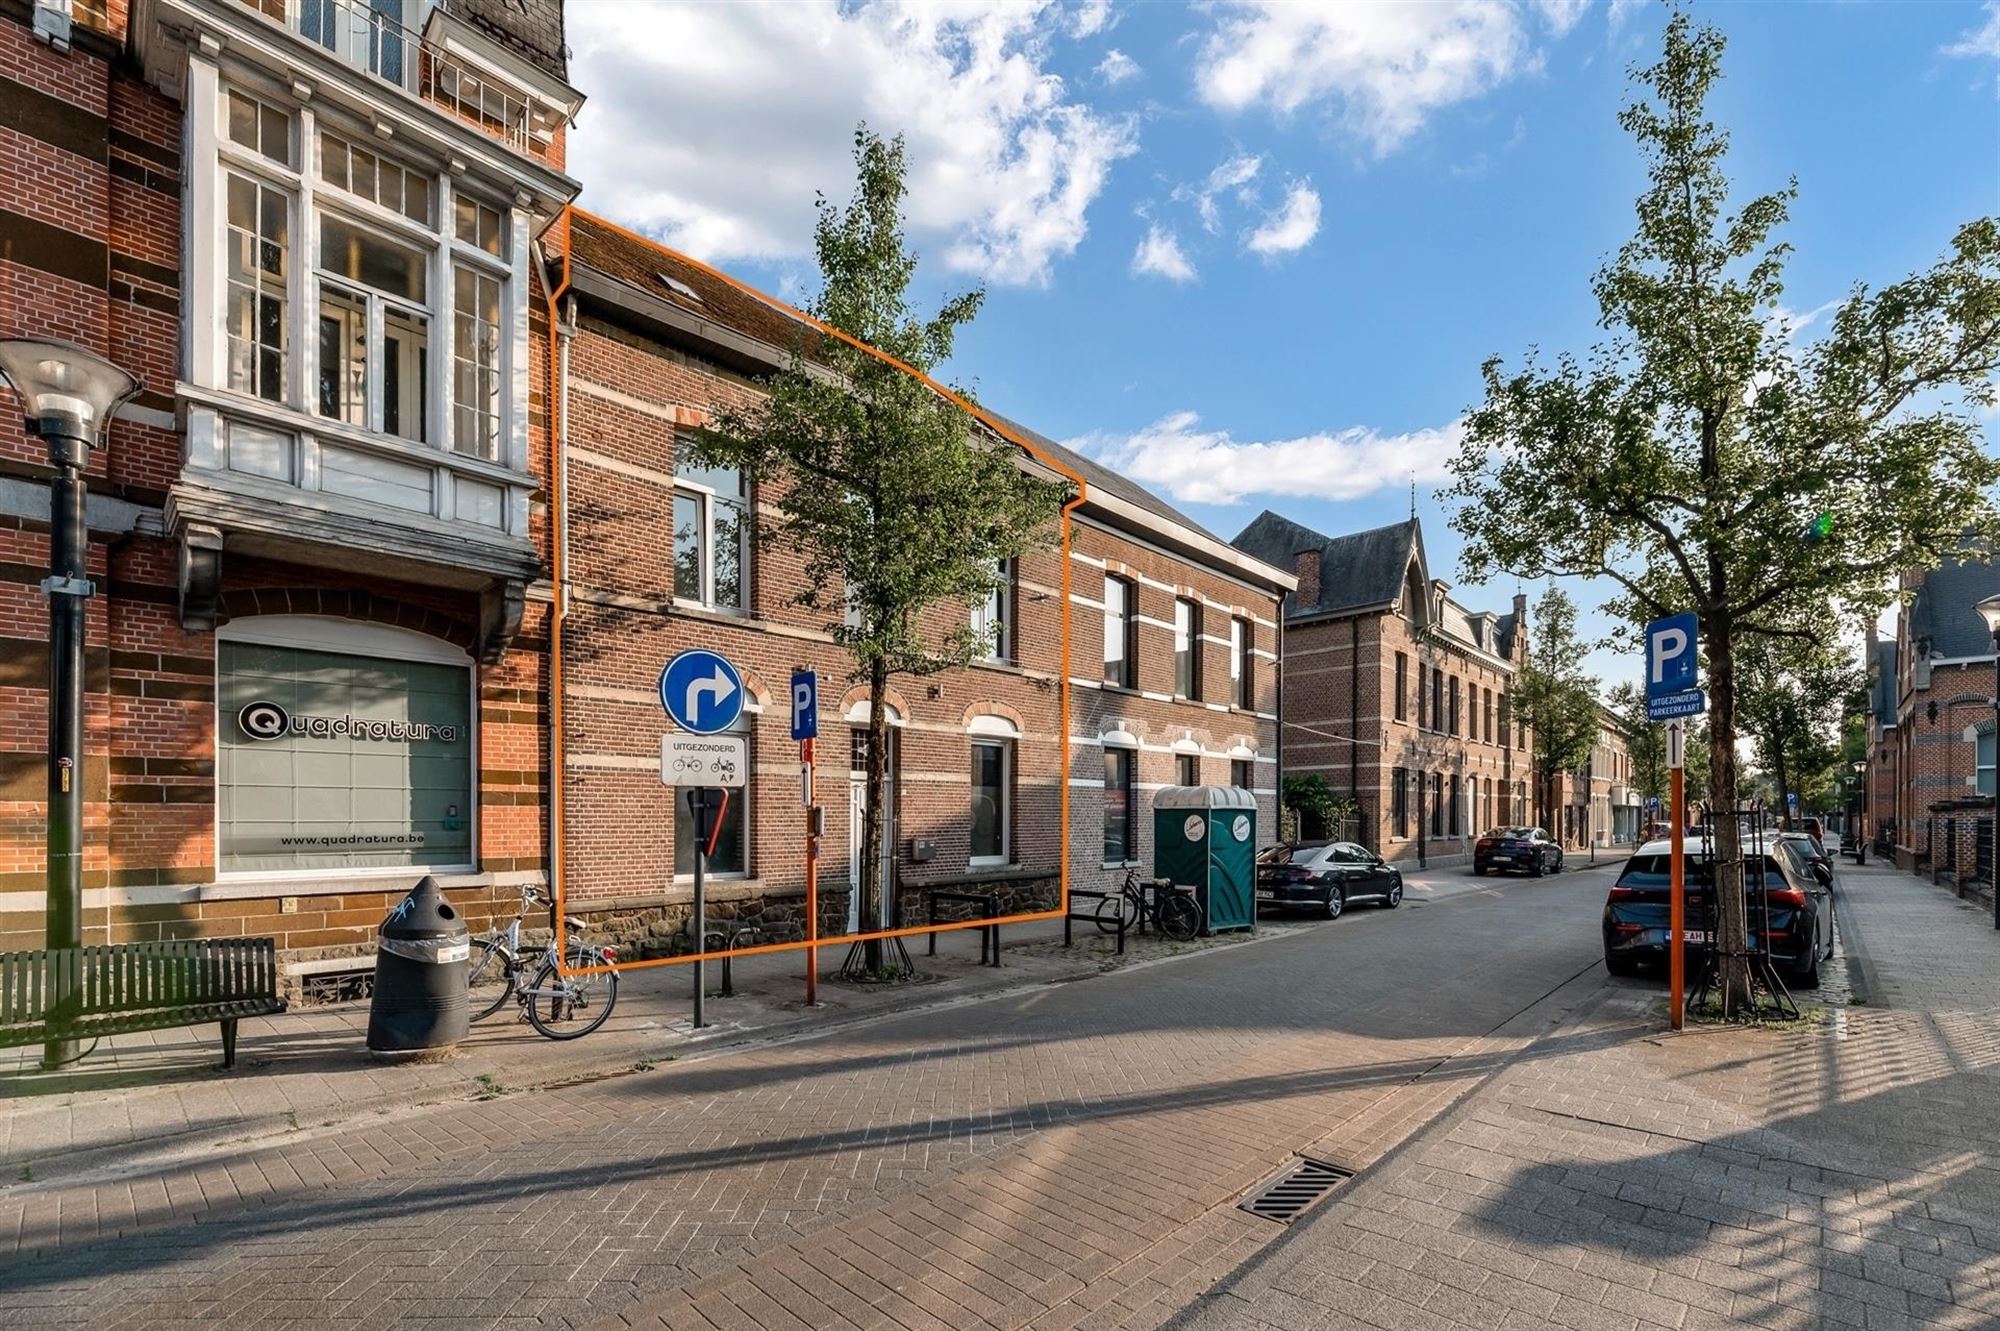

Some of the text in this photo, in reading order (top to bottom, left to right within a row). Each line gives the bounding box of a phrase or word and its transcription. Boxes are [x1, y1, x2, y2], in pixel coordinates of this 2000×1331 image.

[1652, 627, 1687, 684] P
[794, 683, 811, 729] P
[1651, 693, 1699, 707] UITGEZONDERD
[1649, 703, 1700, 717] PARKEERKAART
[238, 700, 457, 742] Quadratura
[673, 743, 736, 753] UITGEZONDERD
[1650, 797, 1657, 806] P
[1787, 793, 1794, 802] P
[280, 833, 425, 847] www.quadratura.be
